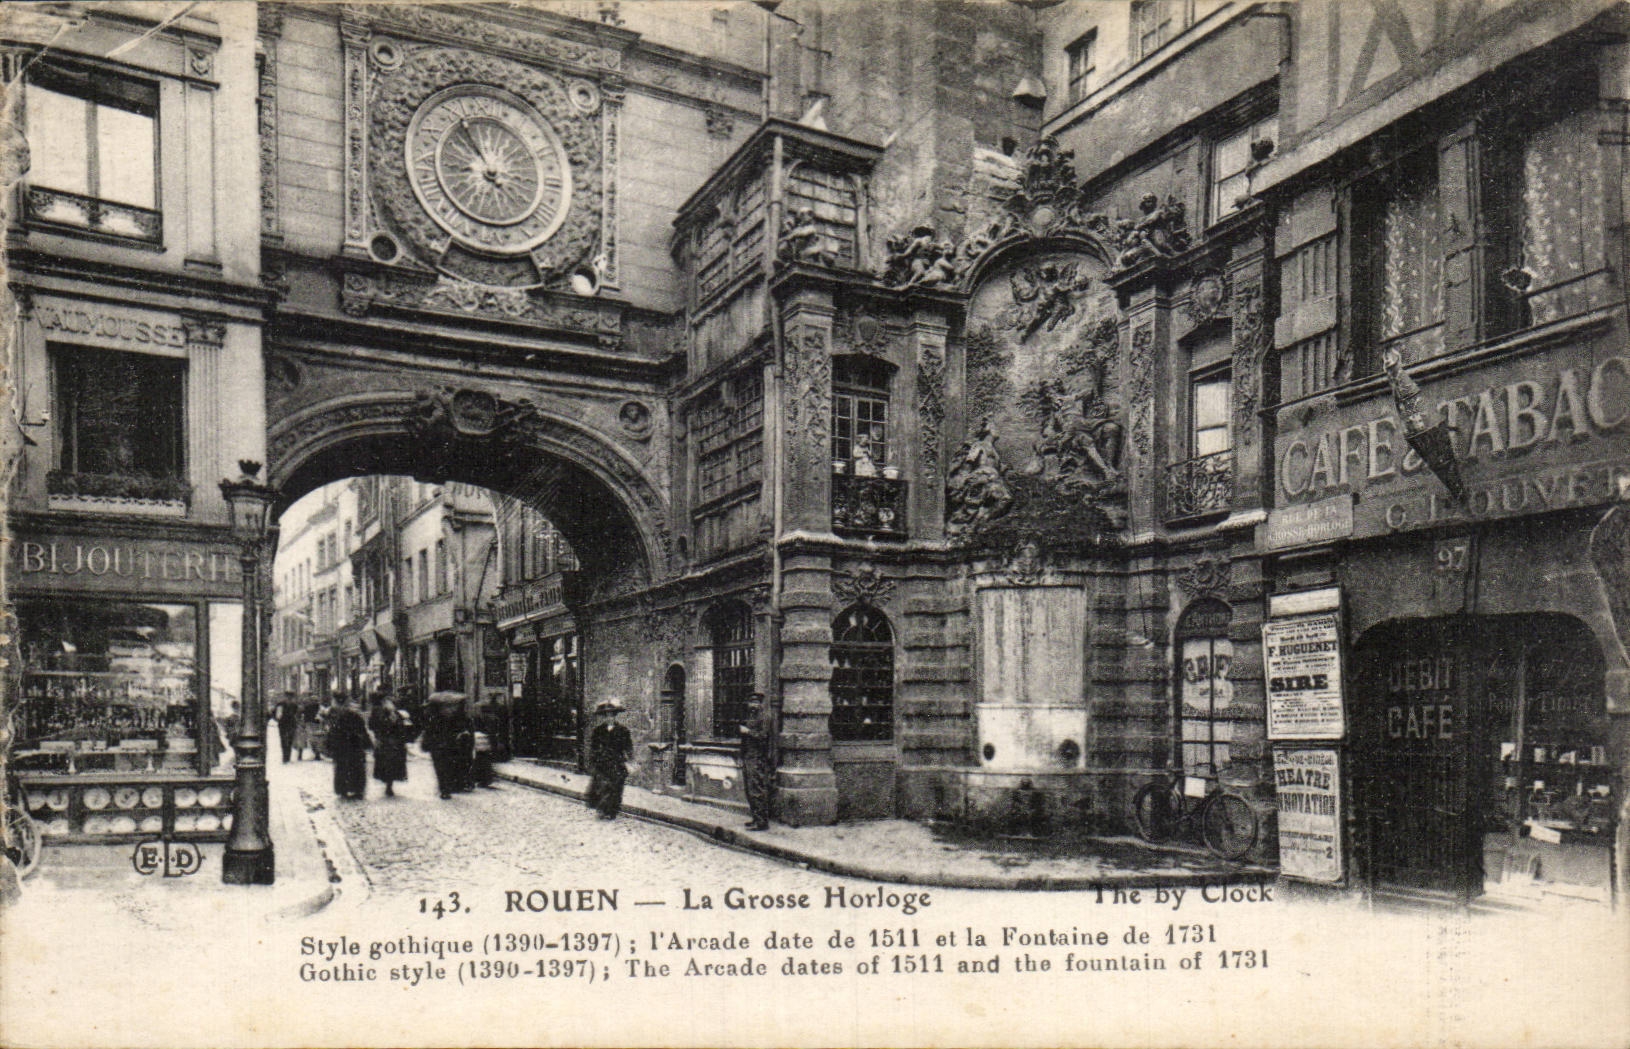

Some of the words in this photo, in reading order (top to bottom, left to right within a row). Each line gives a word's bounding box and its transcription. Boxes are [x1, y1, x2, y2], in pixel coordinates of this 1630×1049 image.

[1281, 416, 1396, 496] CAFE
[1437, 357, 1630, 458] TABAC
[22, 541, 243, 582] BIJOUTERIE
[1438, 545, 1467, 570] 97
[1279, 640, 1338, 657] HUGUENET
[1270, 673, 1329, 693] SIRE
